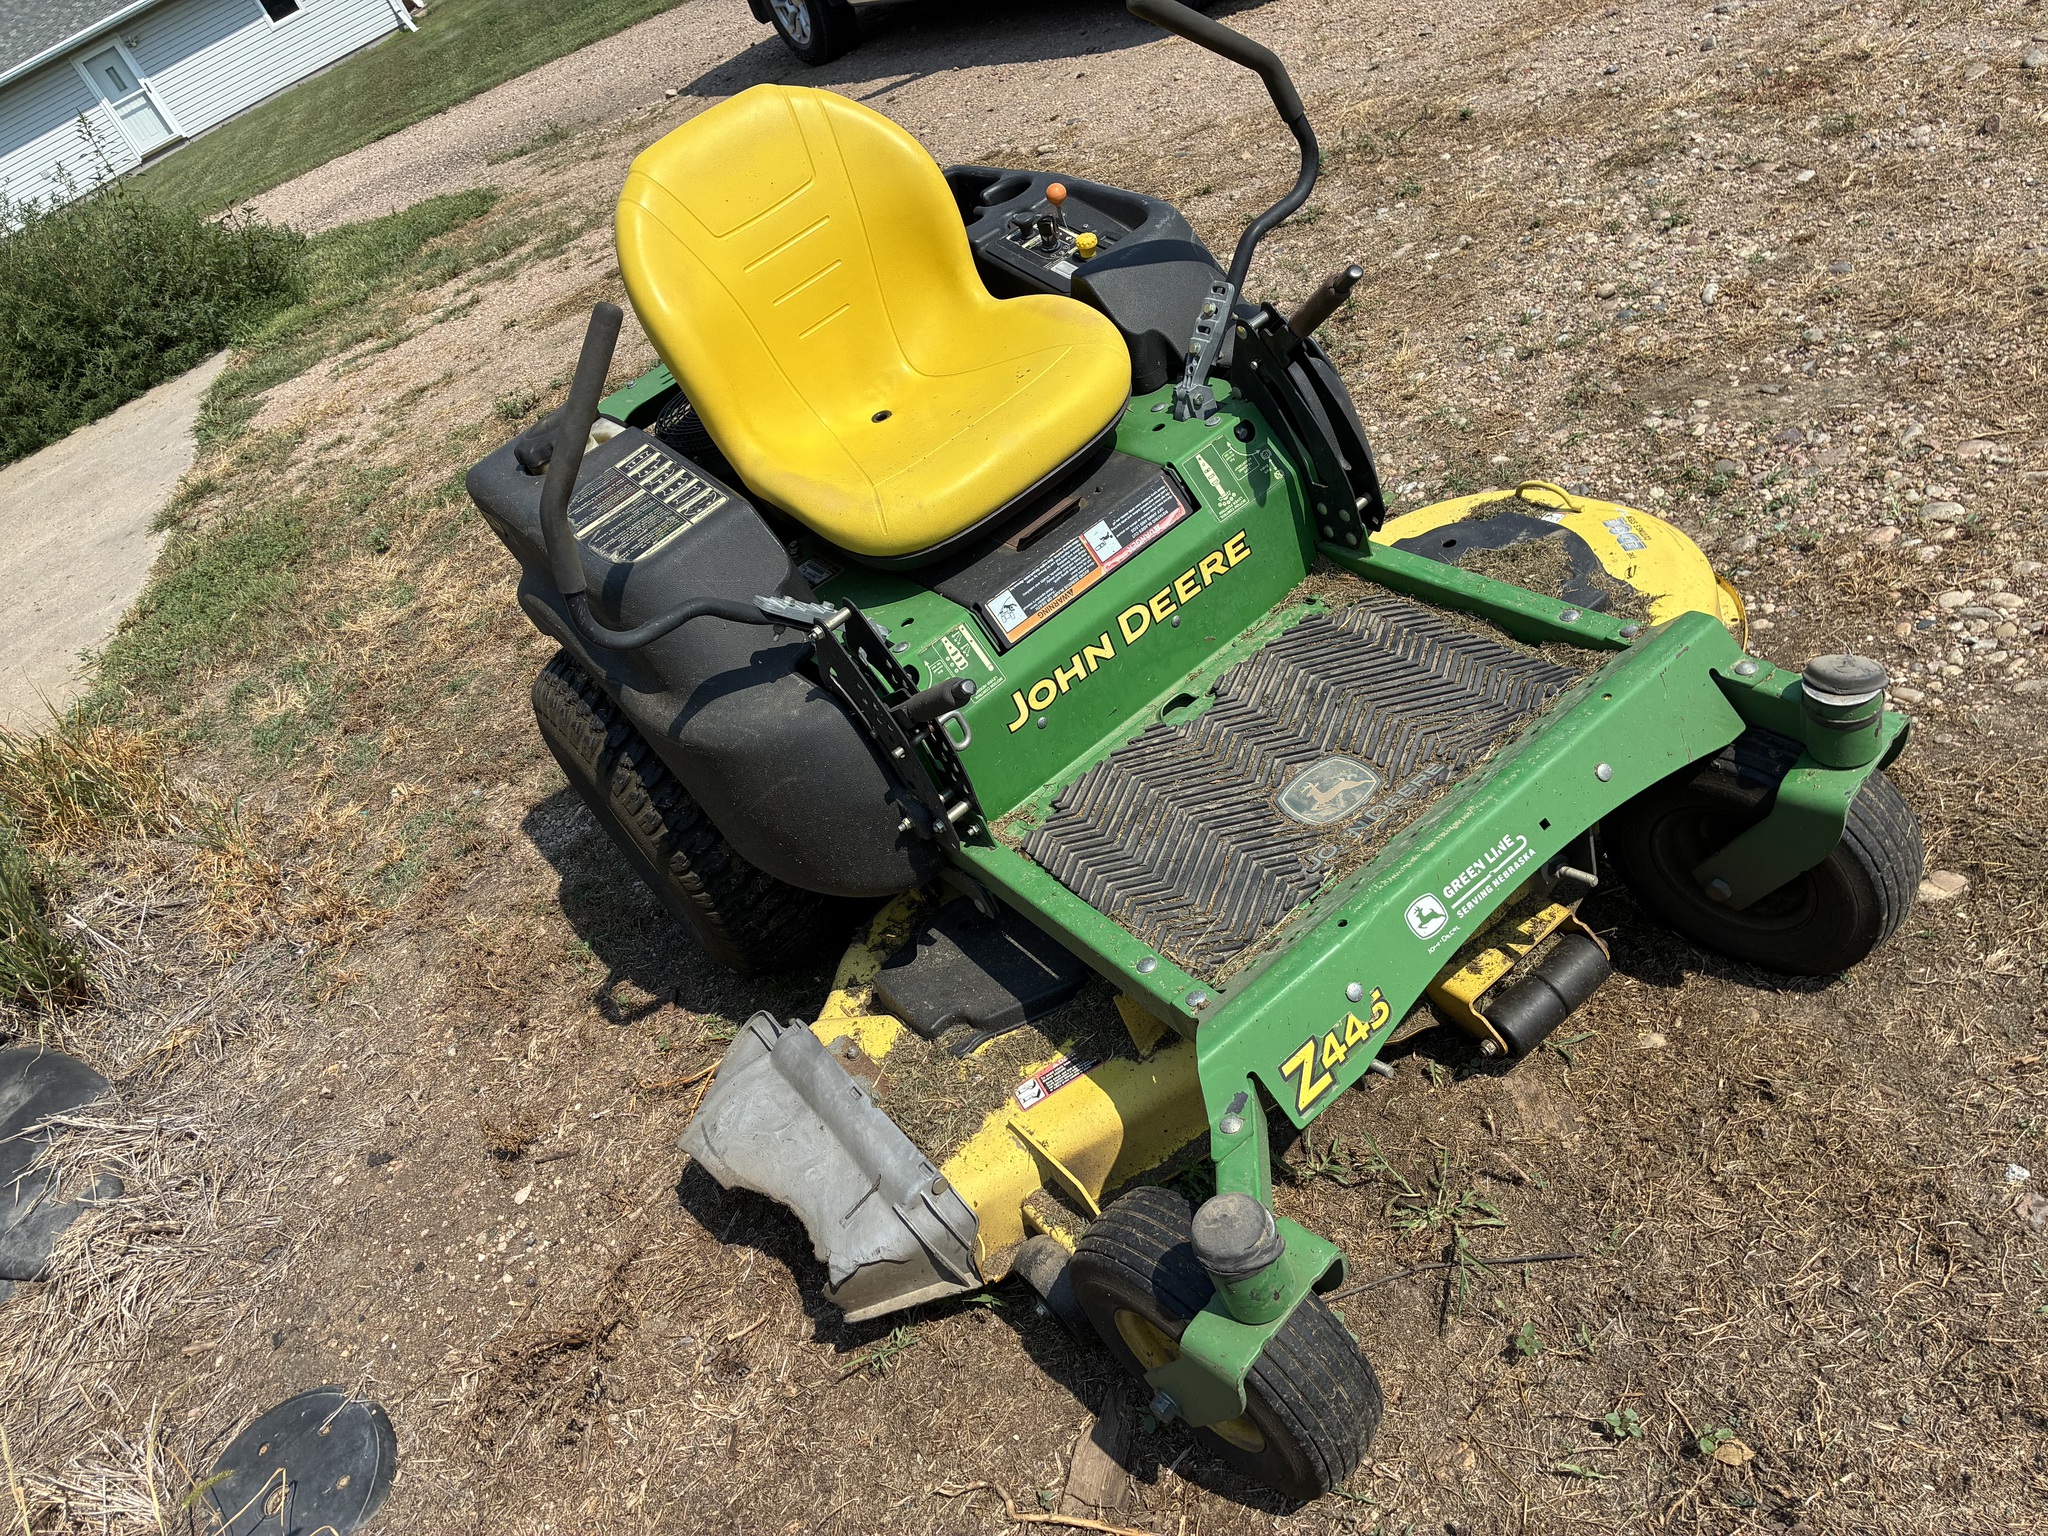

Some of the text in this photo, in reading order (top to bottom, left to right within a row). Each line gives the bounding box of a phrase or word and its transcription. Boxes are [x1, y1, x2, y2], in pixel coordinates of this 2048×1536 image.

[1130, 524, 1140, 533] LEGS
[1138, 521, 1152, 533] BLADES
[1139, 518, 1147, 526] AND
[1151, 509, 1168, 523] ROTATING
[1126, 527, 1154, 552] DANGER
[1601, 516, 1646, 551] EDGE
[1036, 592, 1070, 619] WARNING
[1008, 528, 1252, 733] JOHN DEERE
[1306, 764, 1447, 873] JON DEERE
[1443, 833, 1515, 899] GREEN LINE
[1456, 848, 1536, 918] SERVING NEBRASKA
[1278, 986, 1391, 1116] Z445
